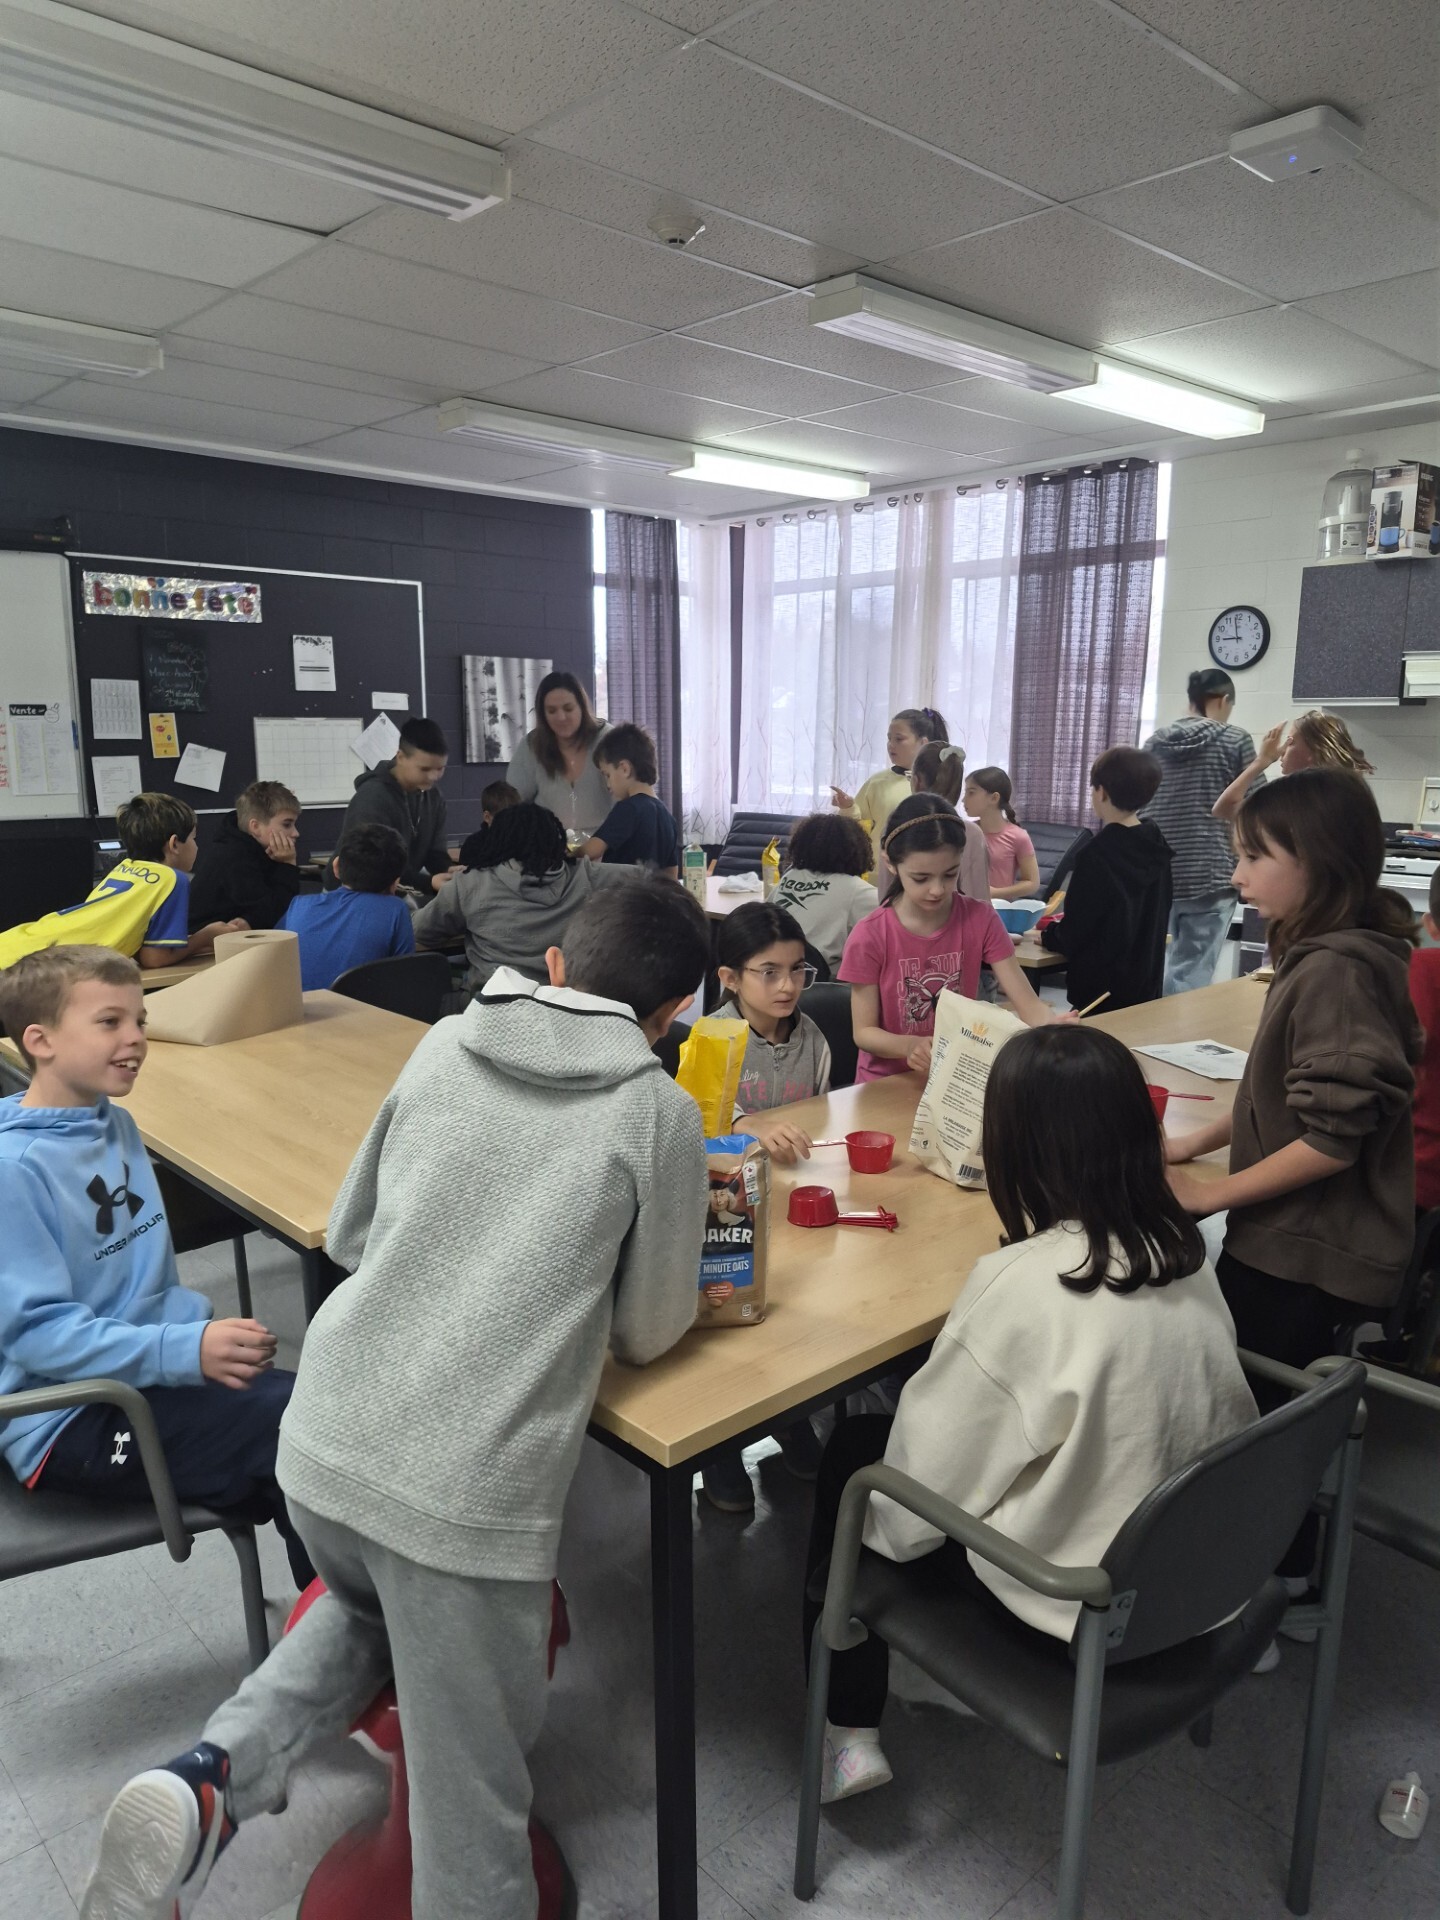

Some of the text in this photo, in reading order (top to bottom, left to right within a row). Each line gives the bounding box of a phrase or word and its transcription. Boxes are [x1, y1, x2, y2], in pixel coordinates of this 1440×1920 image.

[10, 706, 37, 715] Vente
[115, 864, 160, 884] NALDO
[57, 878, 134, 916] 7
[960, 1026, 994, 1048] Milanaise
[703, 1227, 753, 1244] AKER
[93, 1238, 128, 1261] UNDER
[703, 1262, 731, 1274] MINUTE
[732, 1259, 750, 1272] OATS
